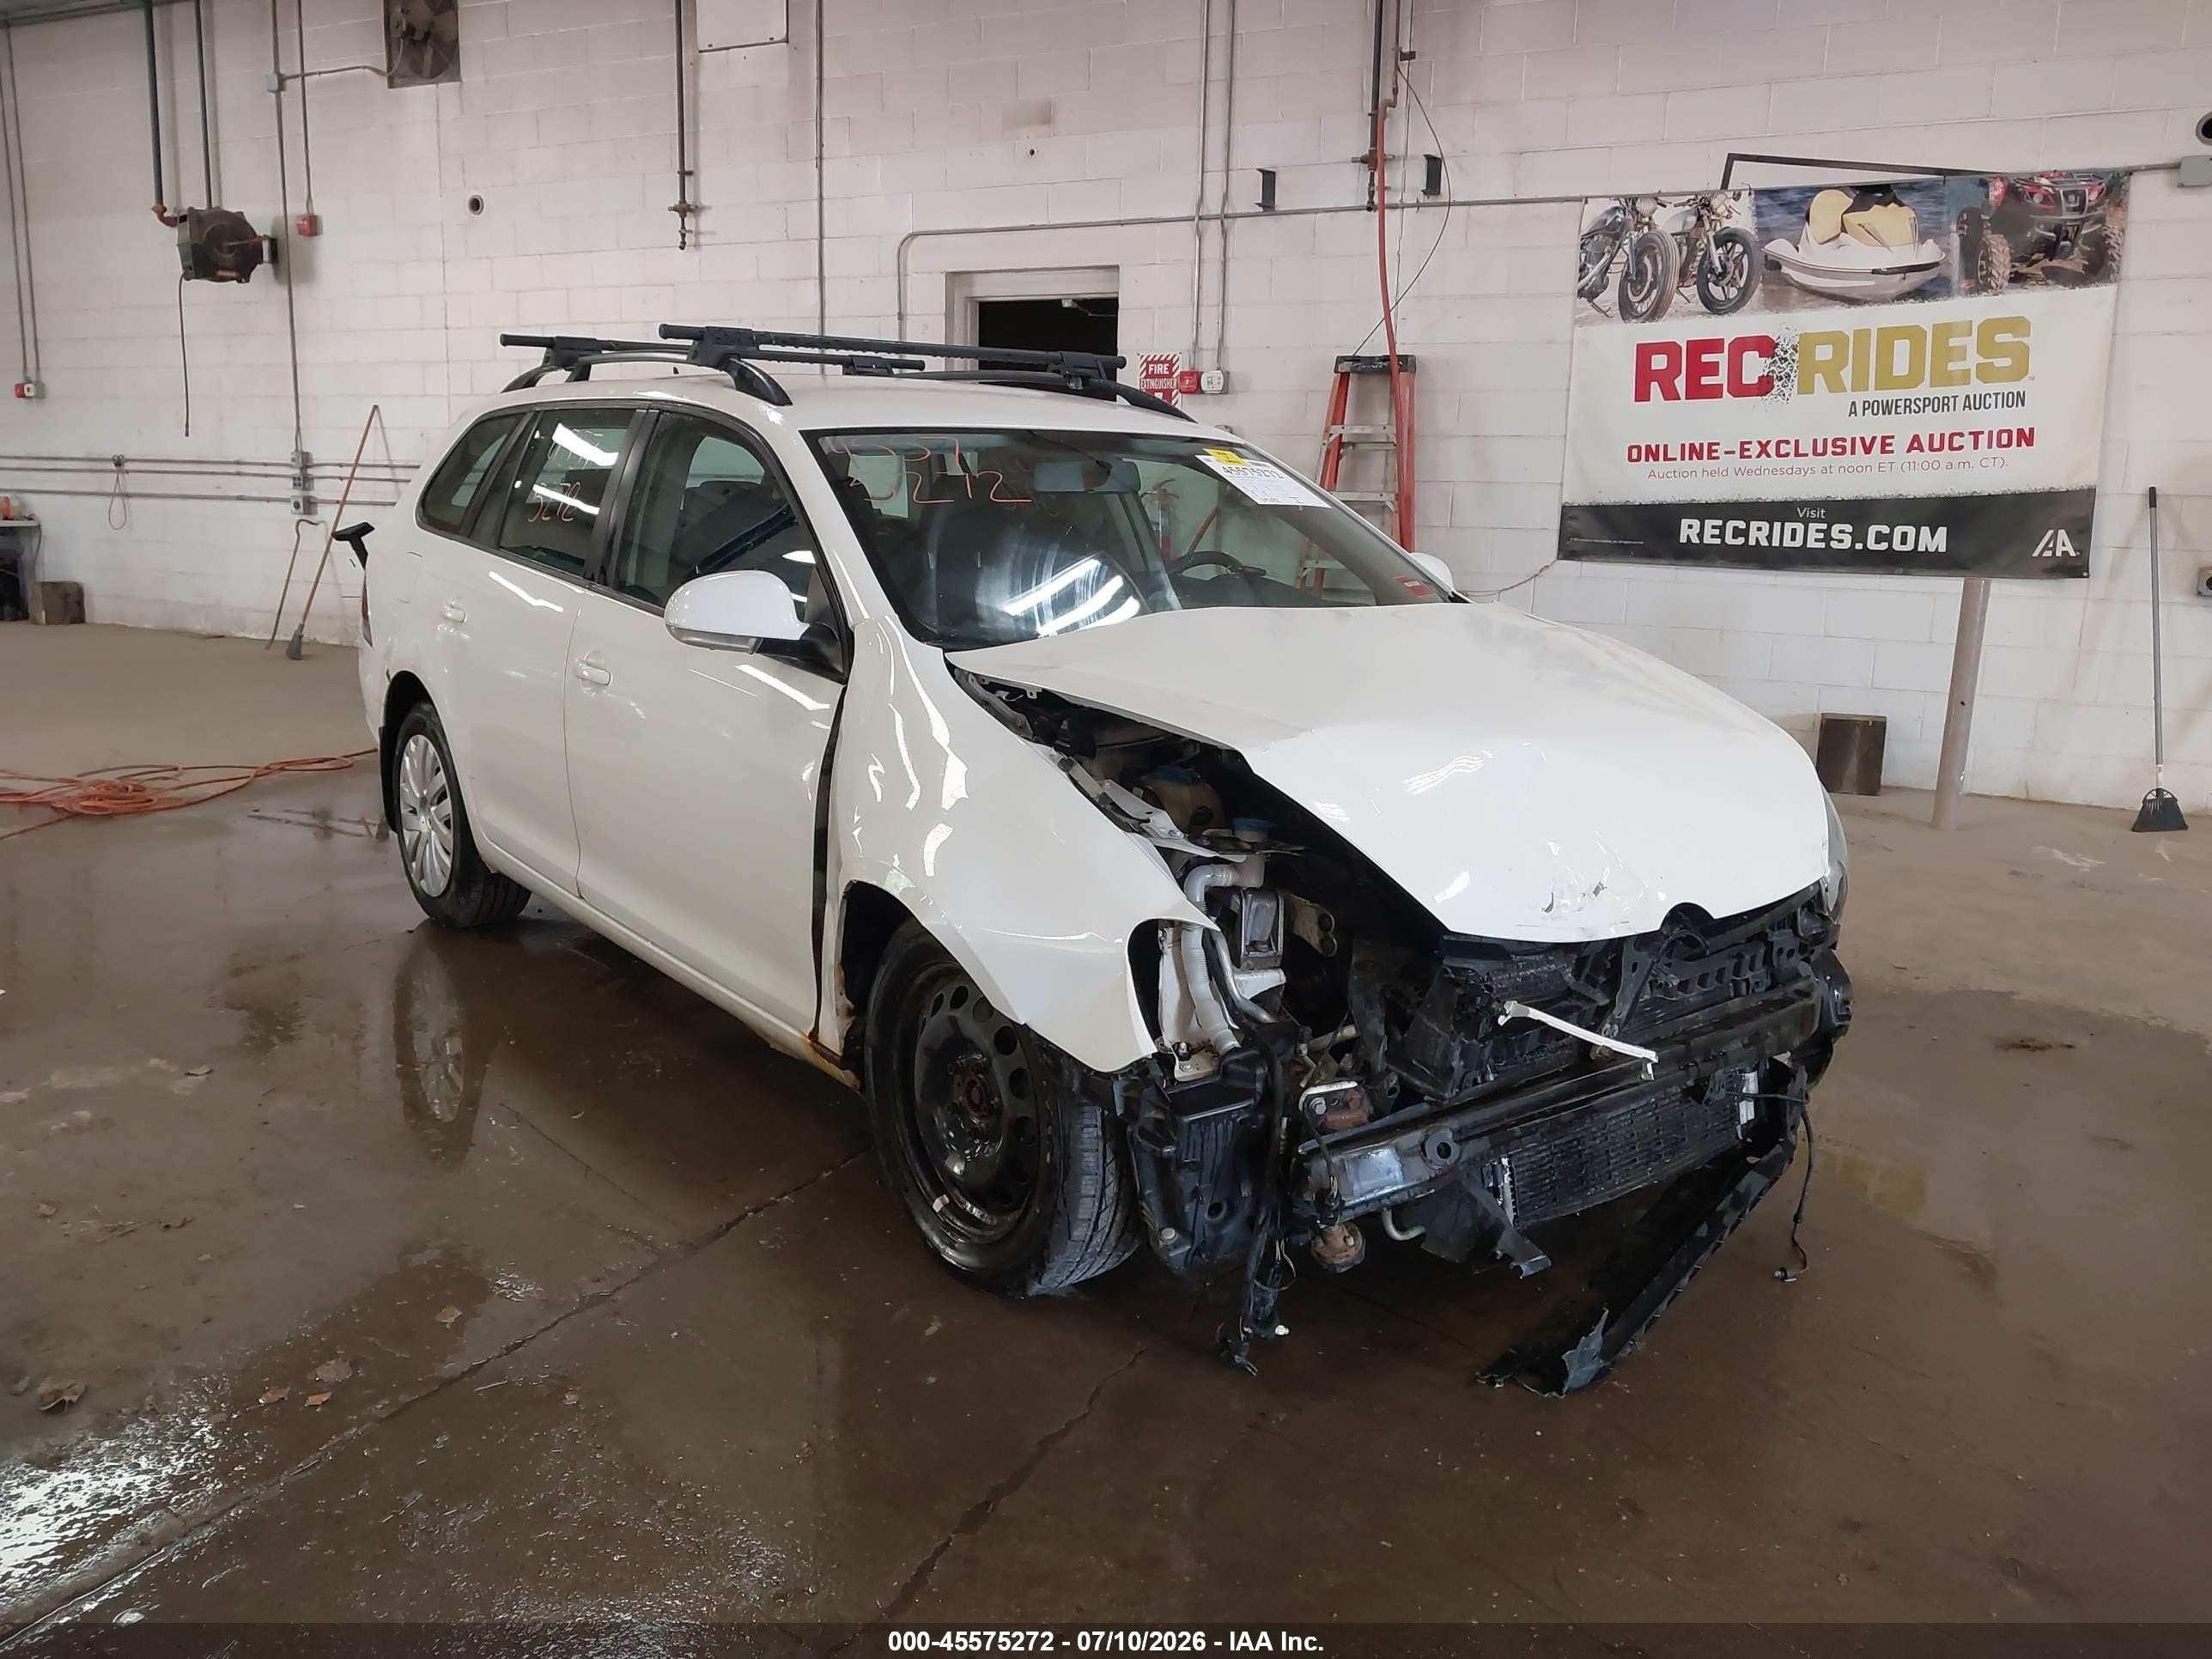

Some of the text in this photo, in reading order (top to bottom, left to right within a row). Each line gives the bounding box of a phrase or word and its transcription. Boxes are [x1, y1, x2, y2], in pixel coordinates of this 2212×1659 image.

[1148, 363, 1170, 375] FIRE
[1634, 315, 2032, 402] REC RIDES
[1140, 378, 1177, 390] EXTINGUISHER
[1848, 390, 2027, 417] A POWERSPORT AUCTION
[1627, 427, 2036, 463] ONLINE-EXCLUSIVE AUCTION
[1647, 456, 2009, 480] Auction held Wednesdays at noon ET (11:00 a.m. CT).
[1796, 507, 1826, 519] Visit
[1679, 518, 1948, 553] RECRIDES.COM
